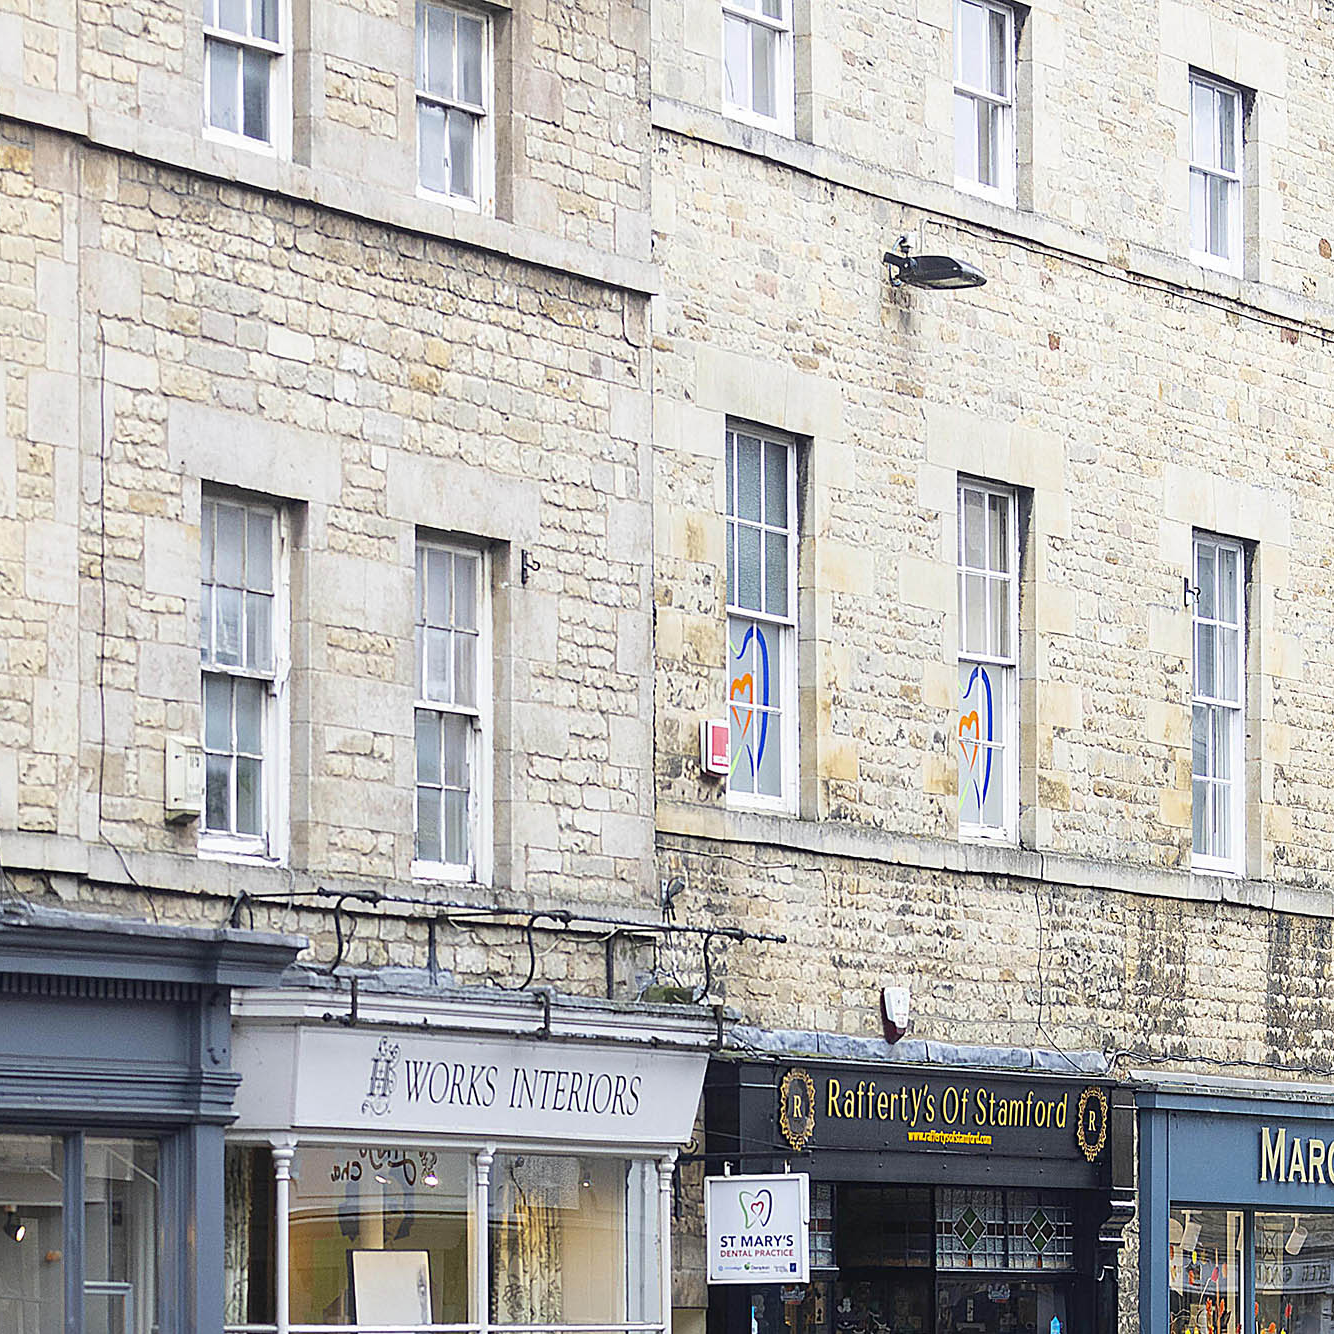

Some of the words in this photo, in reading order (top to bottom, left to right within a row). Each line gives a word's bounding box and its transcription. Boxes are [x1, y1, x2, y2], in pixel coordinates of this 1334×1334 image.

[404, 1059, 498, 1108] WORKS
[509, 1067, 642, 1116] INTERIORS
[792, 1094, 803, 1119] R
[827, 1078, 936, 1127] Rafferty's
[942, 1086, 970, 1126] Of
[974, 1087, 1069, 1129] Stamford
[1087, 1110, 1097, 1132] R
[907, 1130, 993, 1145] www.raffertysofstamford.com
[720, 1235, 737, 1248] ST
[740, 1234, 794, 1247] MARY'S
[720, 1250, 753, 1258] DENTAL
[754, 1248, 794, 1257] PRACTICE
